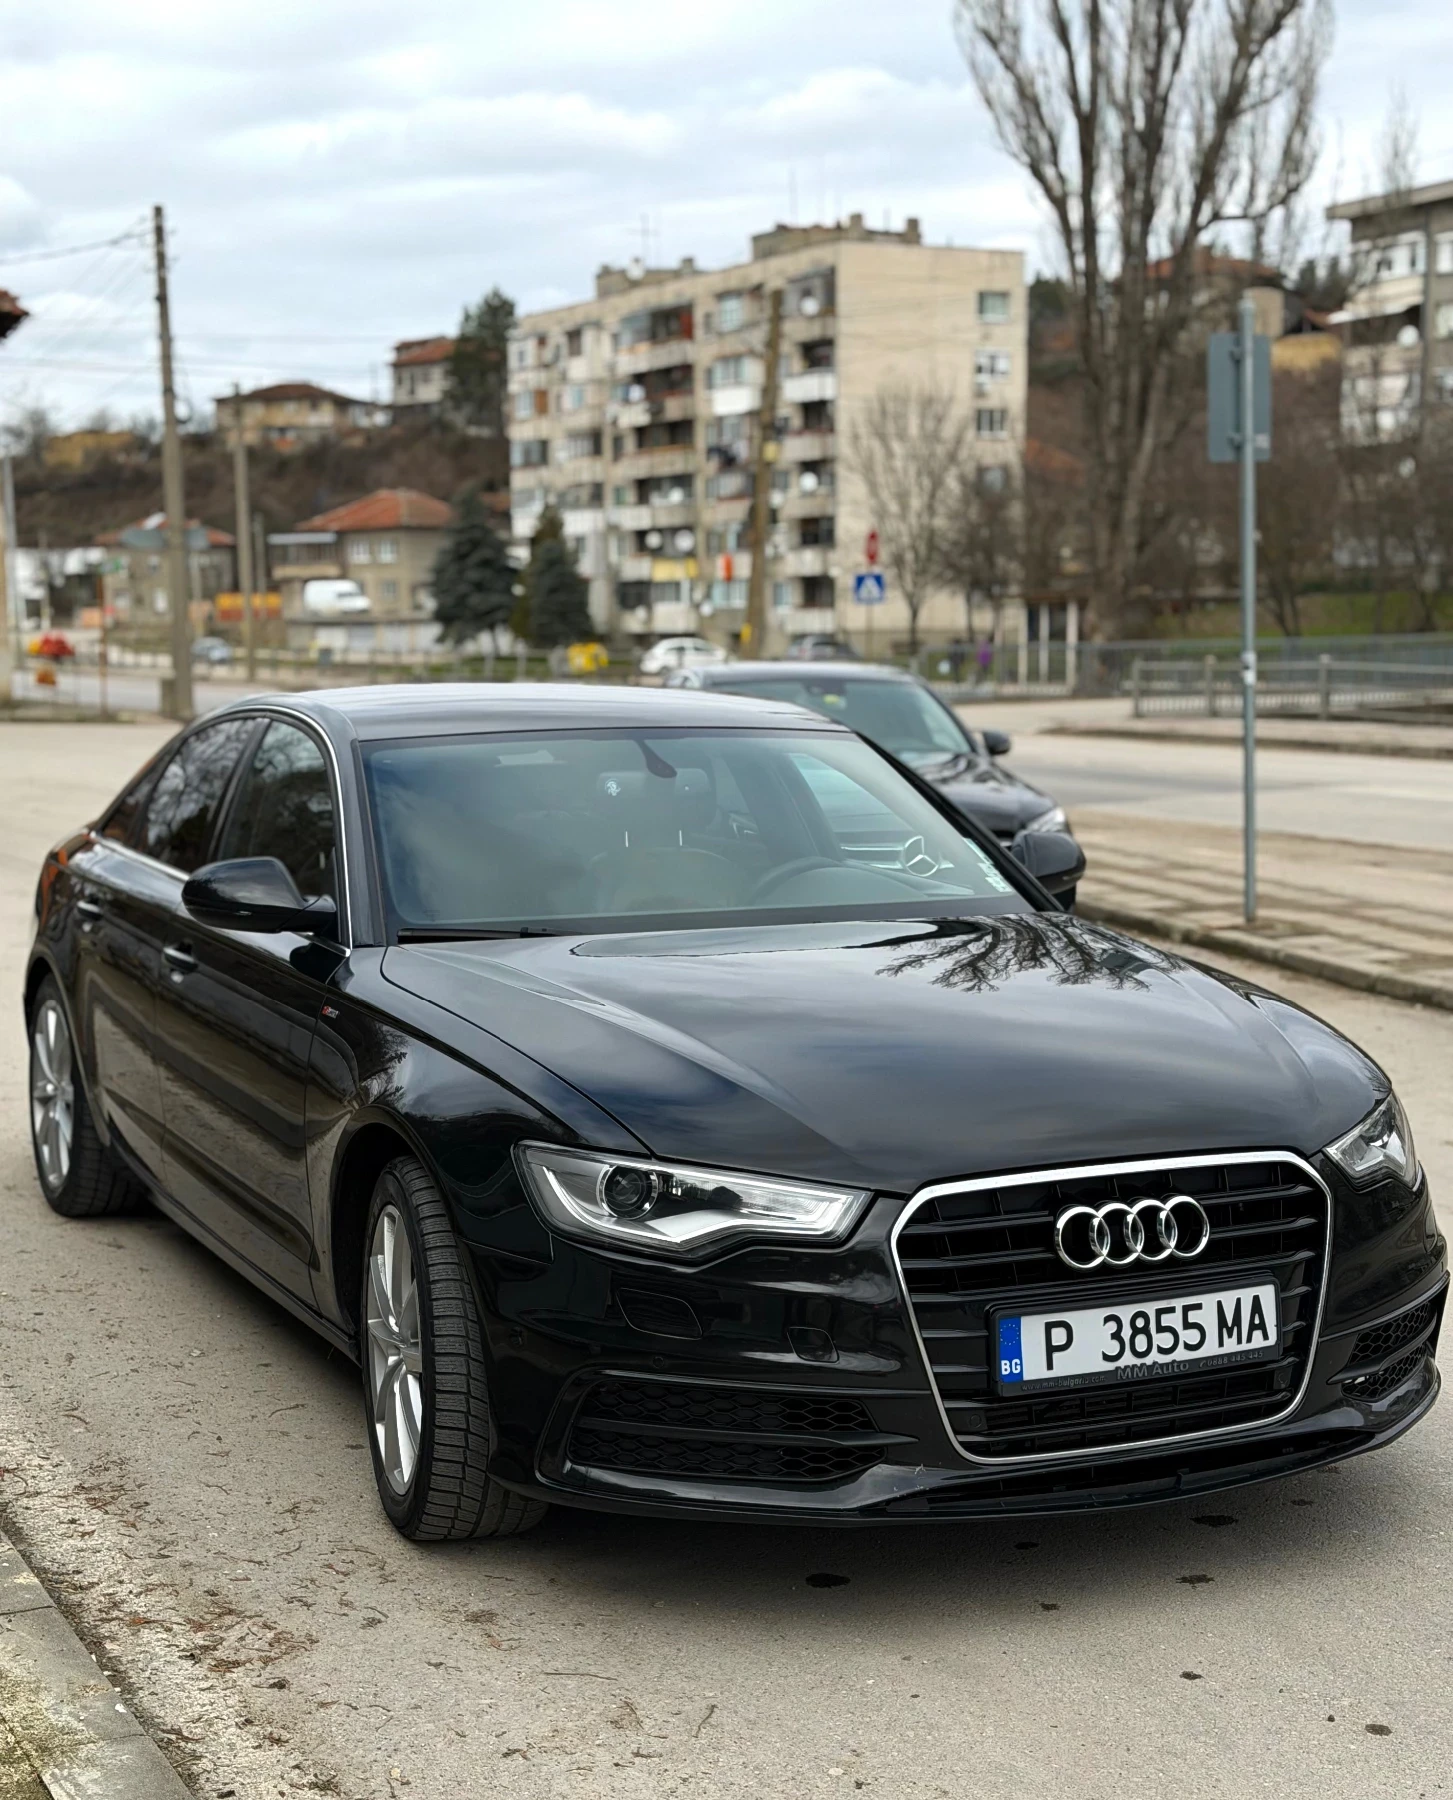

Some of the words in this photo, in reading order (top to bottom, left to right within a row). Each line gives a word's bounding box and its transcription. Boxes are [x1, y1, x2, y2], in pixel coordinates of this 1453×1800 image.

[1044, 1319, 1074, 1371] P
[1101, 1302, 1207, 1363] 3855
[1216, 1294, 1270, 1348] MA
[1001, 1358, 1021, 1375] BG
[1116, 1364, 1149, 1380] MM
[1151, 1361, 1190, 1376] Auto
